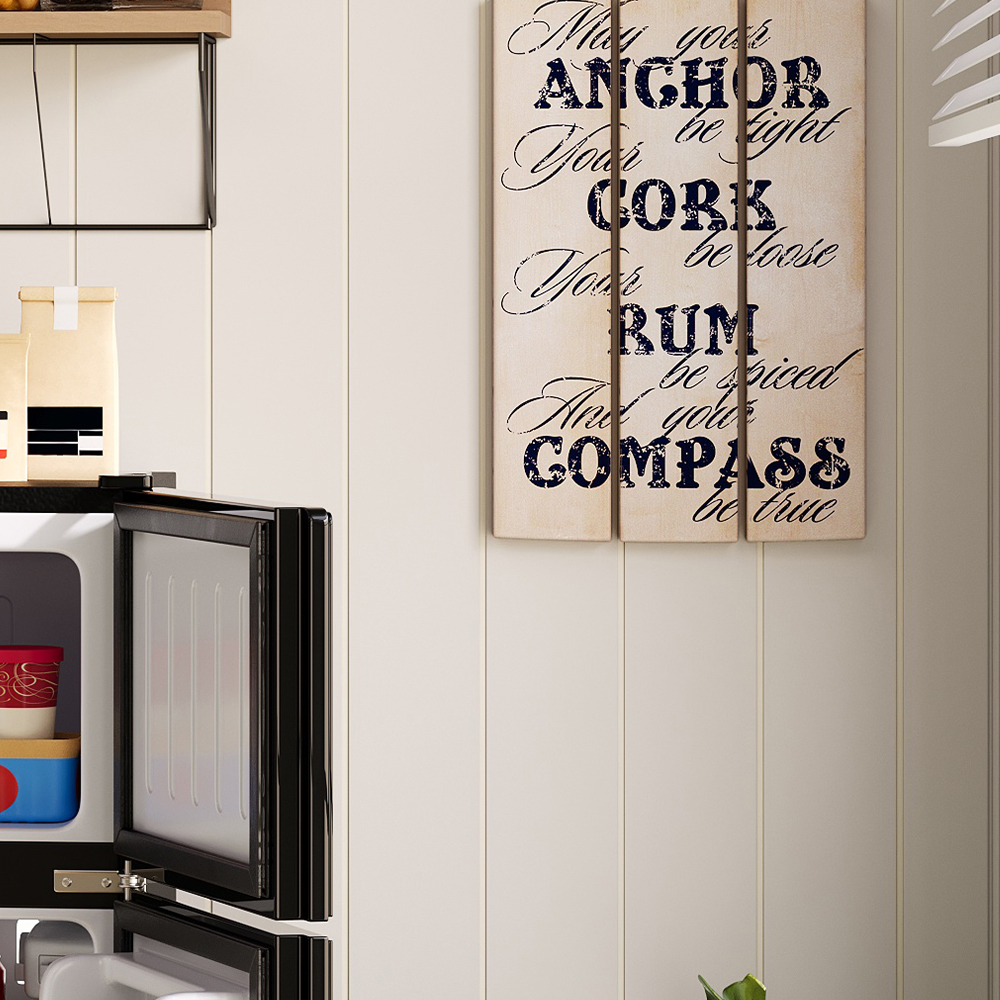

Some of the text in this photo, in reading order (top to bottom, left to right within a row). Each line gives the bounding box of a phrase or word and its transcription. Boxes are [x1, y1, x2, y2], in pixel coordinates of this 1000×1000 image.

[507, 0, 773, 60] May your
[533, 56, 830, 110] ANCHOR
[501, 123, 644, 191] Your
[674, 107, 852, 164] be tight
[586, 178, 776, 232] CORK
[683, 226, 839, 268] be loose
[501, 248, 644, 315] Your
[607, 302, 759, 356] RUM
[507, 376, 758, 437] And your
[659, 347, 864, 411] be spiced
[523, 435, 851, 490] COMPASS
[692, 488, 837, 523] be true
